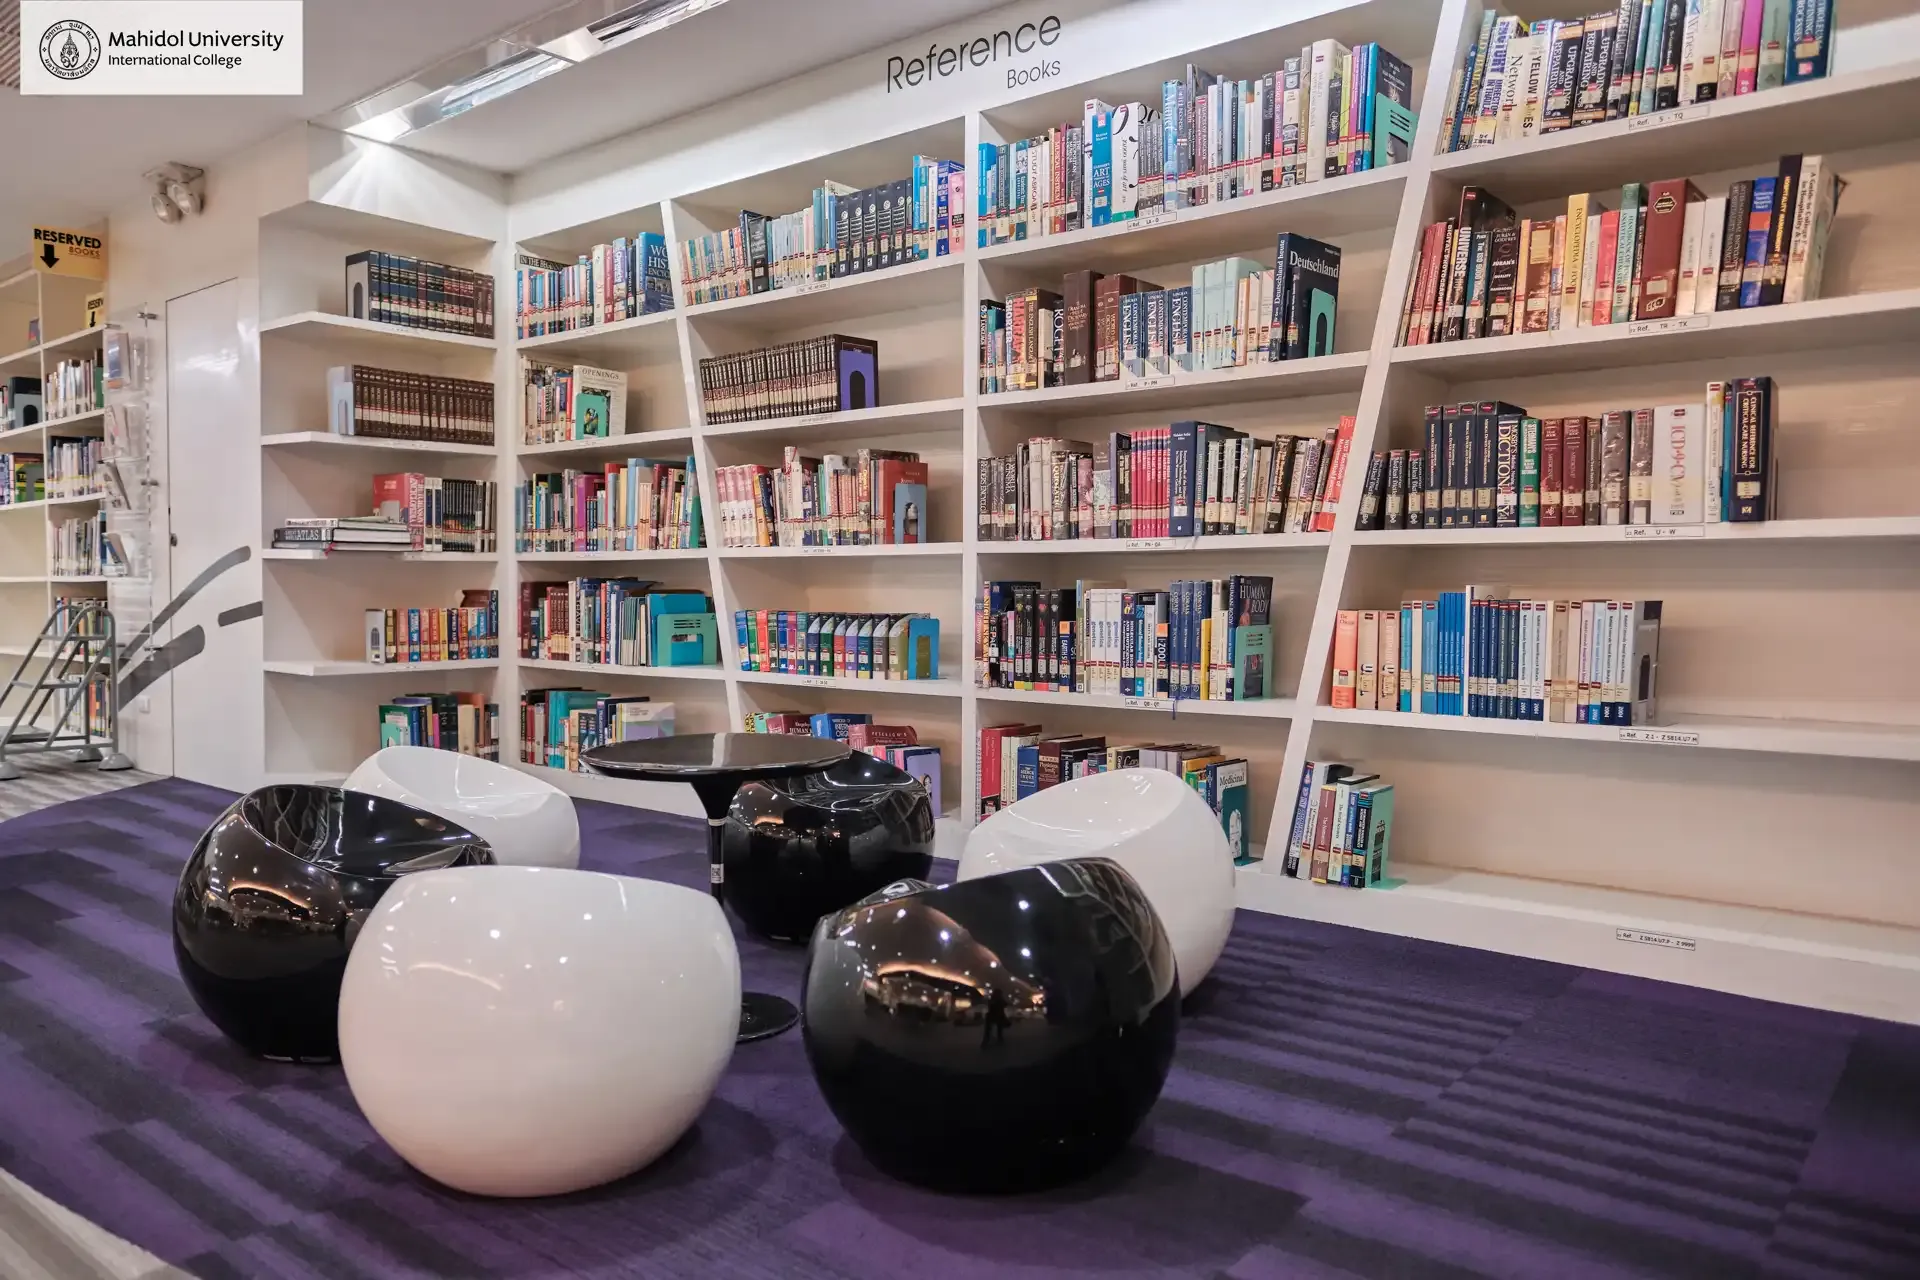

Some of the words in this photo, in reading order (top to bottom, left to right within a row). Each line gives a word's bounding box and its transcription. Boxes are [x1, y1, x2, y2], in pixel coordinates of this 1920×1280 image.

[1684, 15, 1700, 60] Wines
[887, 15, 1061, 93] Reference
[1548, 40, 1563, 96] REPAIRING
[1579, 32, 1596, 88] REPAIRING
[1007, 59, 1061, 89] Books
[1468, 53, 1485, 105] THAILAND
[1528, 55, 1542, 95] YELLOW
[1590, 61, 1598, 76] AND
[1674, 112, 1684, 120] TQ
[1093, 178, 1110, 188] AGES
[1094, 166, 1110, 178] ART
[1780, 175, 1791, 213] HOSPITALITY
[33, 228, 101, 249] RESERVED
[1572, 207, 1583, 263] ENCYCLOPEDIA
[1774, 213, 1786, 252] MANAGEMENT
[69, 246, 100, 257] BOOKS
[1289, 250, 1340, 278] Deutschland
[1454, 226, 1472, 278] UNIVERSE
[1274, 261, 1284, 304] Deutschland
[582, 367, 620, 380] OPENINGS
[1510, 424, 1518, 453] MOSBY'S
[1411, 459, 1419, 479] Medical
[1741, 441, 1749, 469] NURSING
[1497, 425, 1511, 517] DICTIONAY
[297, 529, 319, 540] ATLAS
[1239, 584, 1266, 599] HUMAN
[1251, 600, 1269, 613] BODY
[1218, 769, 1245, 787] Medicinal
